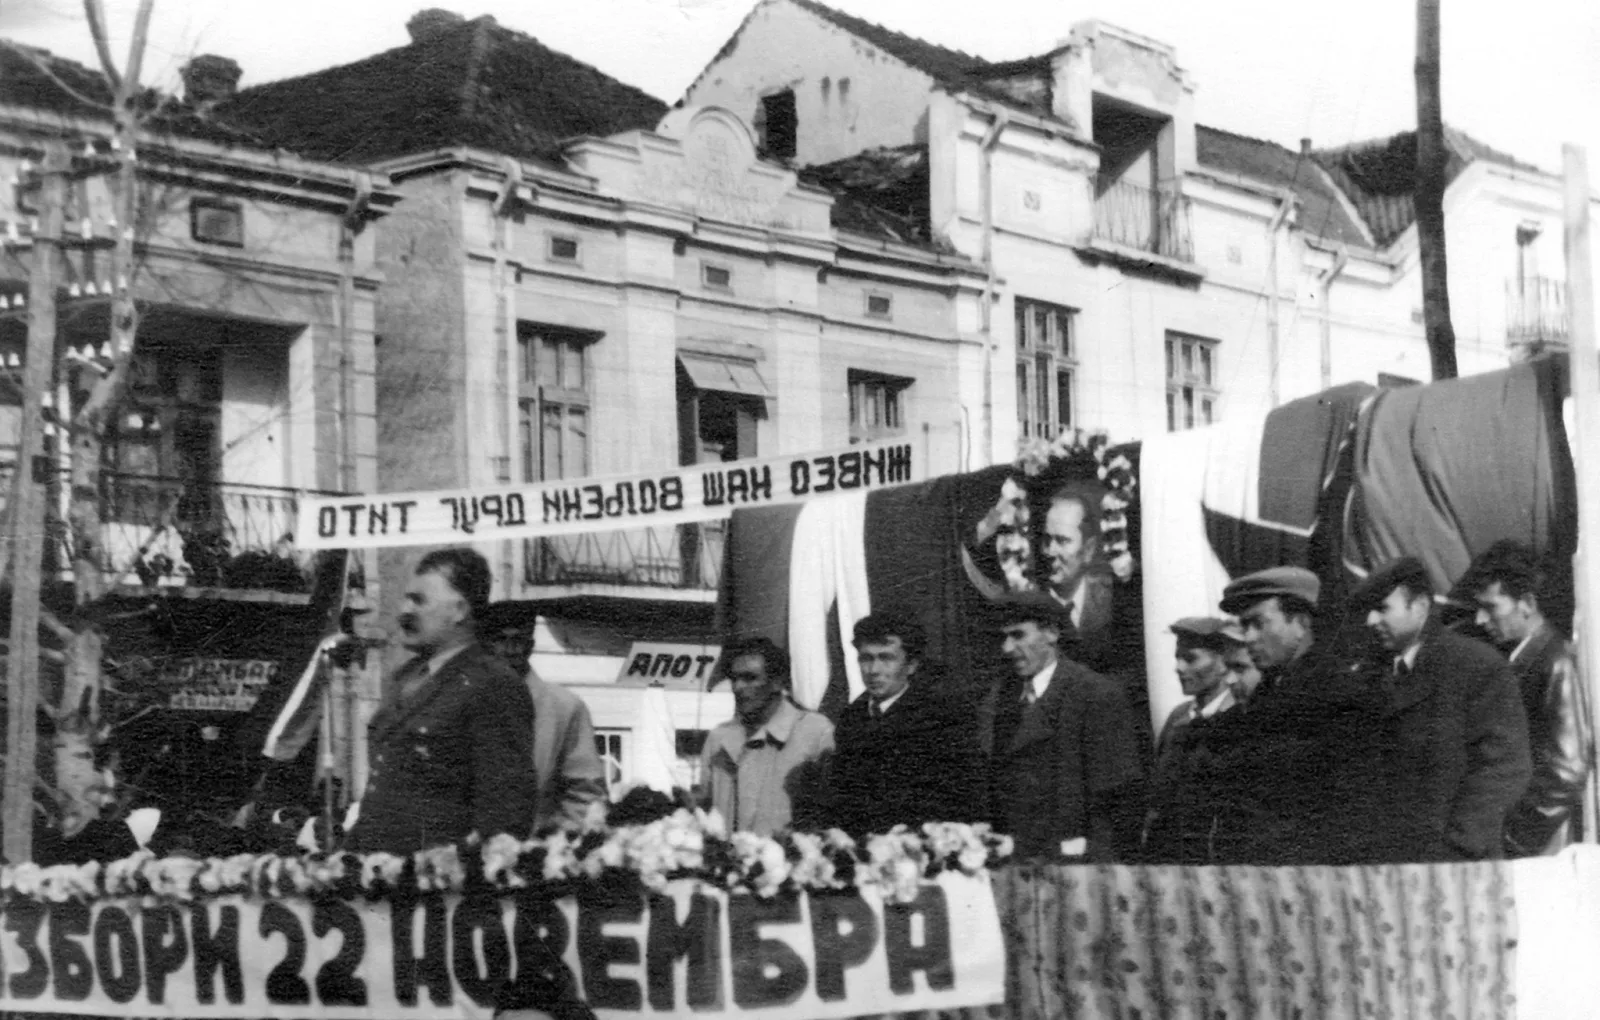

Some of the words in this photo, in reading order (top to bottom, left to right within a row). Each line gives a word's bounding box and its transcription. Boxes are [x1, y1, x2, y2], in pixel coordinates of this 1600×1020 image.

[0, 900, 245, 1005] ЗБОРИ
[258, 900, 369, 1007] 22
[390, 886, 956, 1011] НОВЕМБРА
